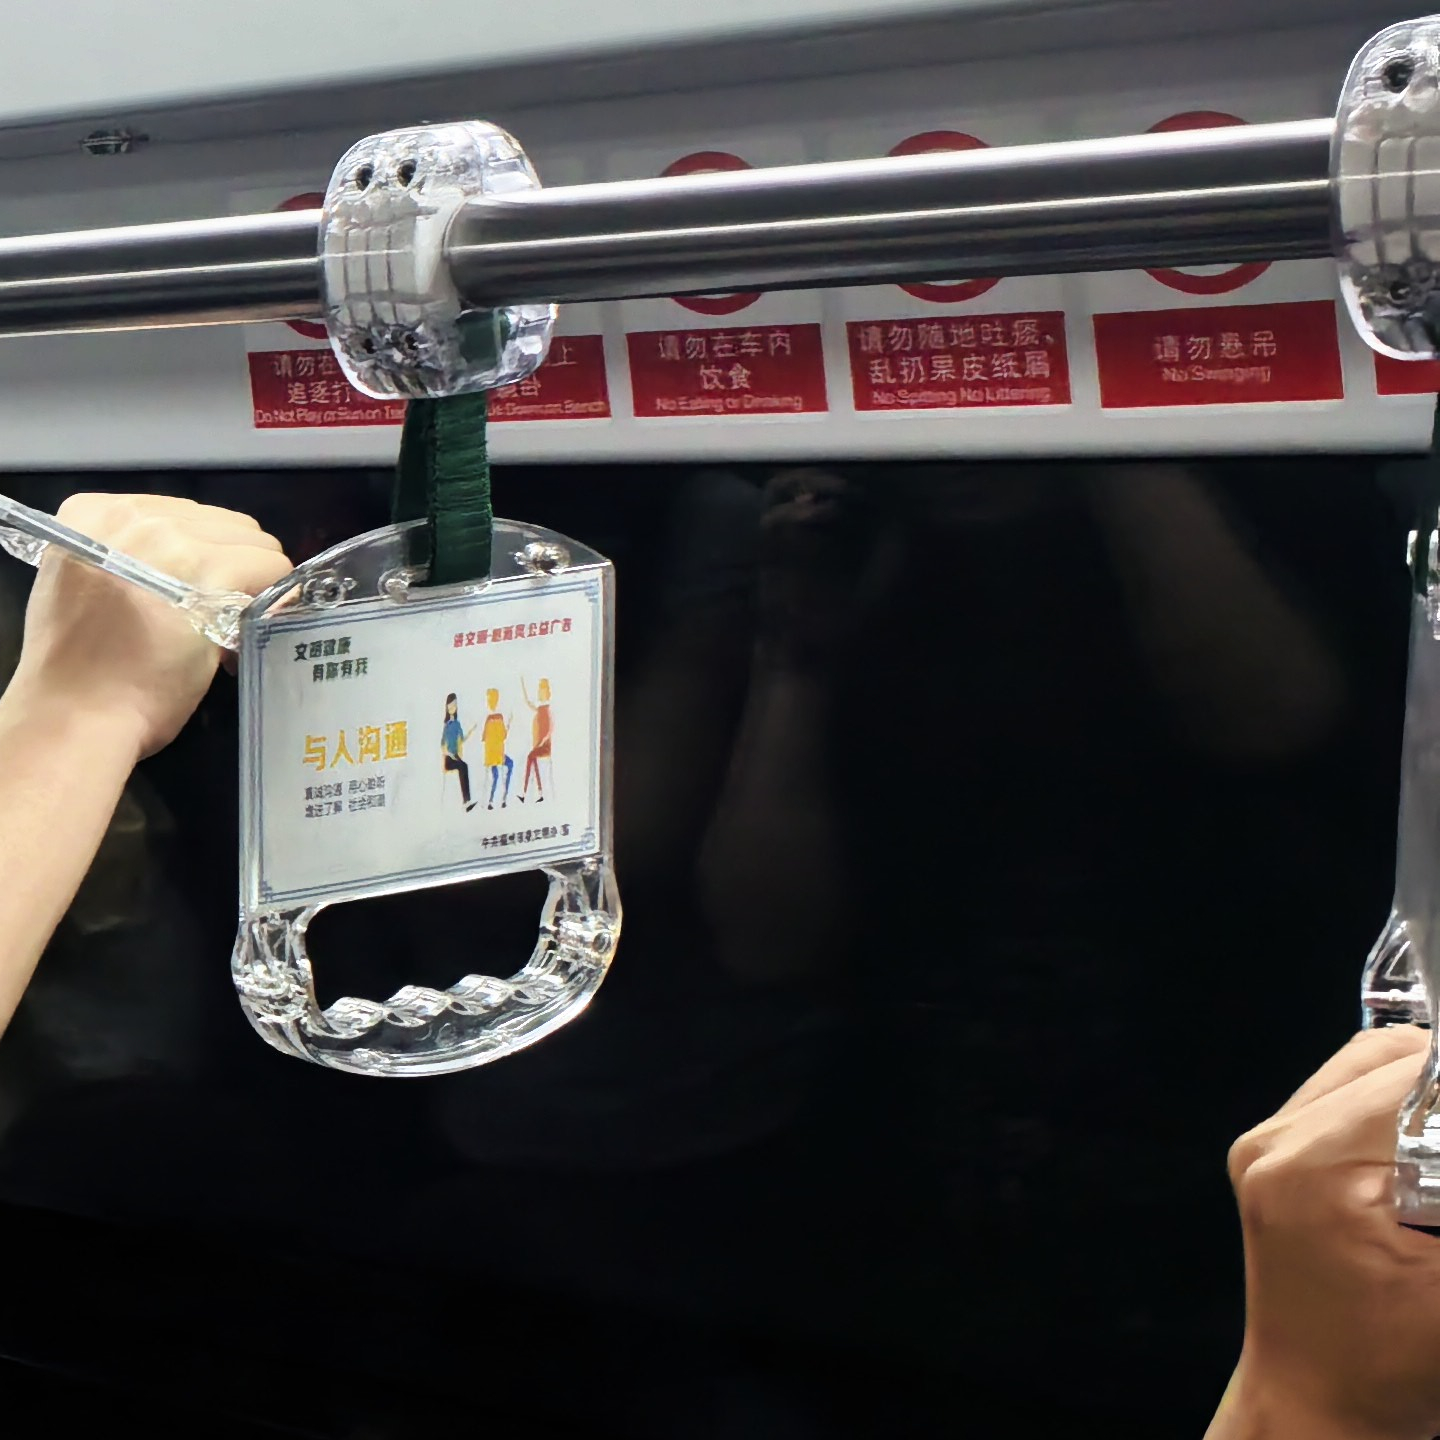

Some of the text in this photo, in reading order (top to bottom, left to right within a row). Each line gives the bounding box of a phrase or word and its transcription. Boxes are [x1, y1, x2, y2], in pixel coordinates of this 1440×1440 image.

[658, 330, 793, 360] 请勿在车内
[1153, 330, 1277, 362] 请勿悬吊
[699, 363, 752, 391] 饮食
[870, 350, 1051, 384] 乱扔果皮纸屑
[1162, 367, 1188, 382] No
[656, 398, 677, 410] No
[873, 390, 895, 406] No
[960, 387, 983, 403] No
[302, 721, 408, 772] 与人沟通
